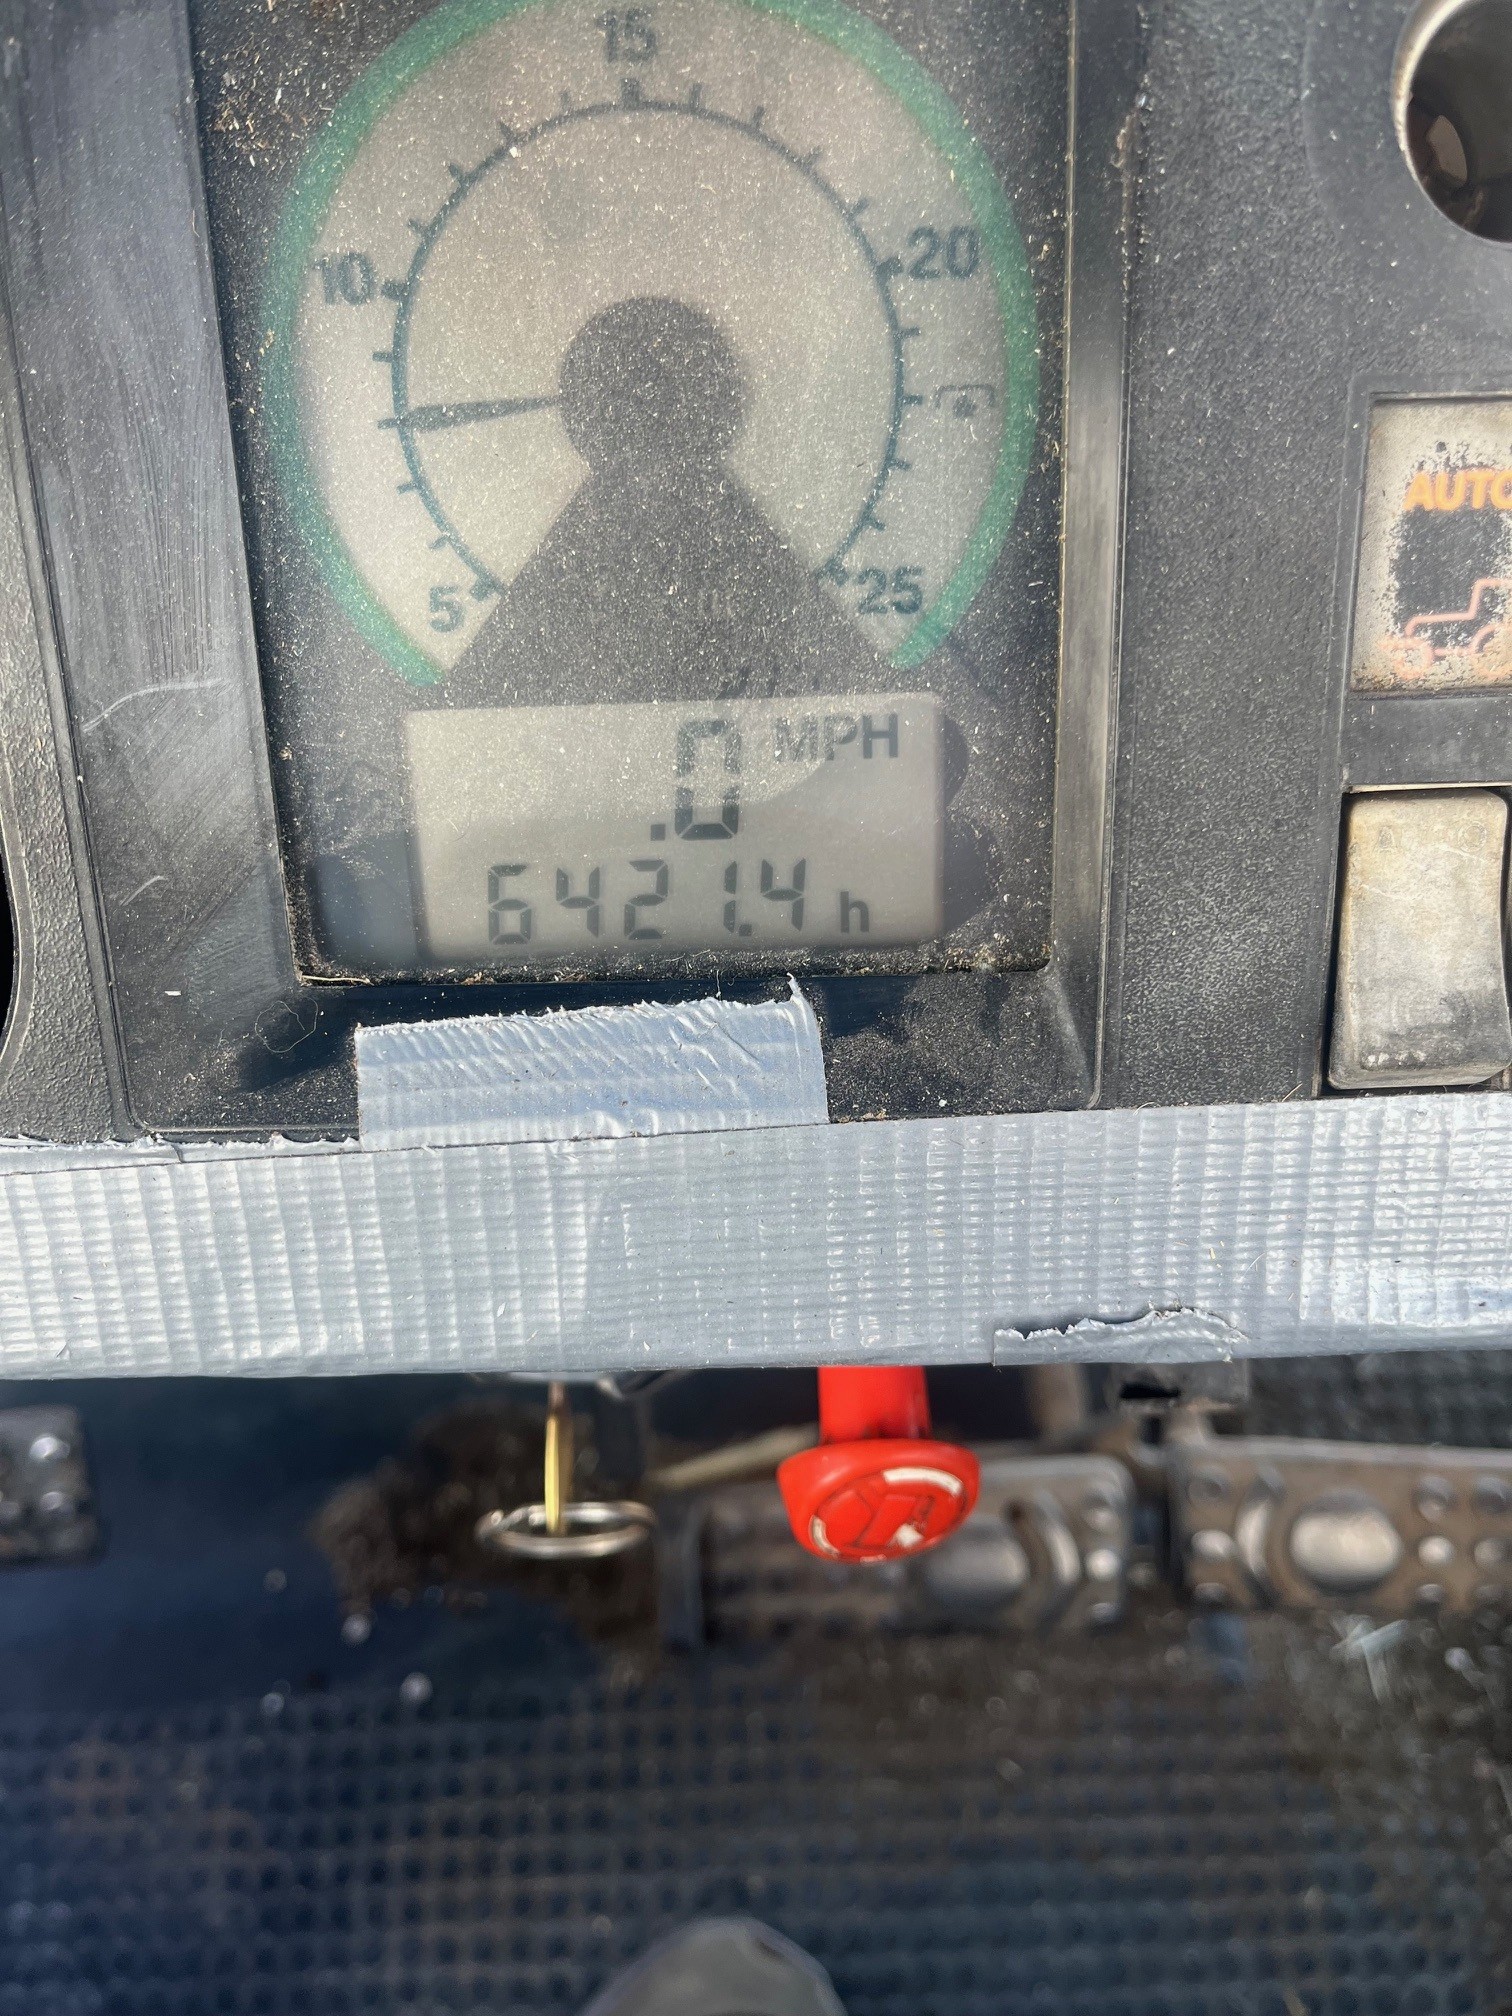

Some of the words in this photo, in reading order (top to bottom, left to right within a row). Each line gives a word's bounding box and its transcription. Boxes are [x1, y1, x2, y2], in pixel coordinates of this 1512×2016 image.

[594, 6, 658, 63] 15
[311, 252, 374, 306] 10
[907, 225, 980, 280] 20
[429, 585, 466, 633] 5
[857, 565, 922, 615] 25
[774, 713, 898, 762] MPH
[488, 858, 806, 945] 6421.4
[839, 891, 869, 934] h
